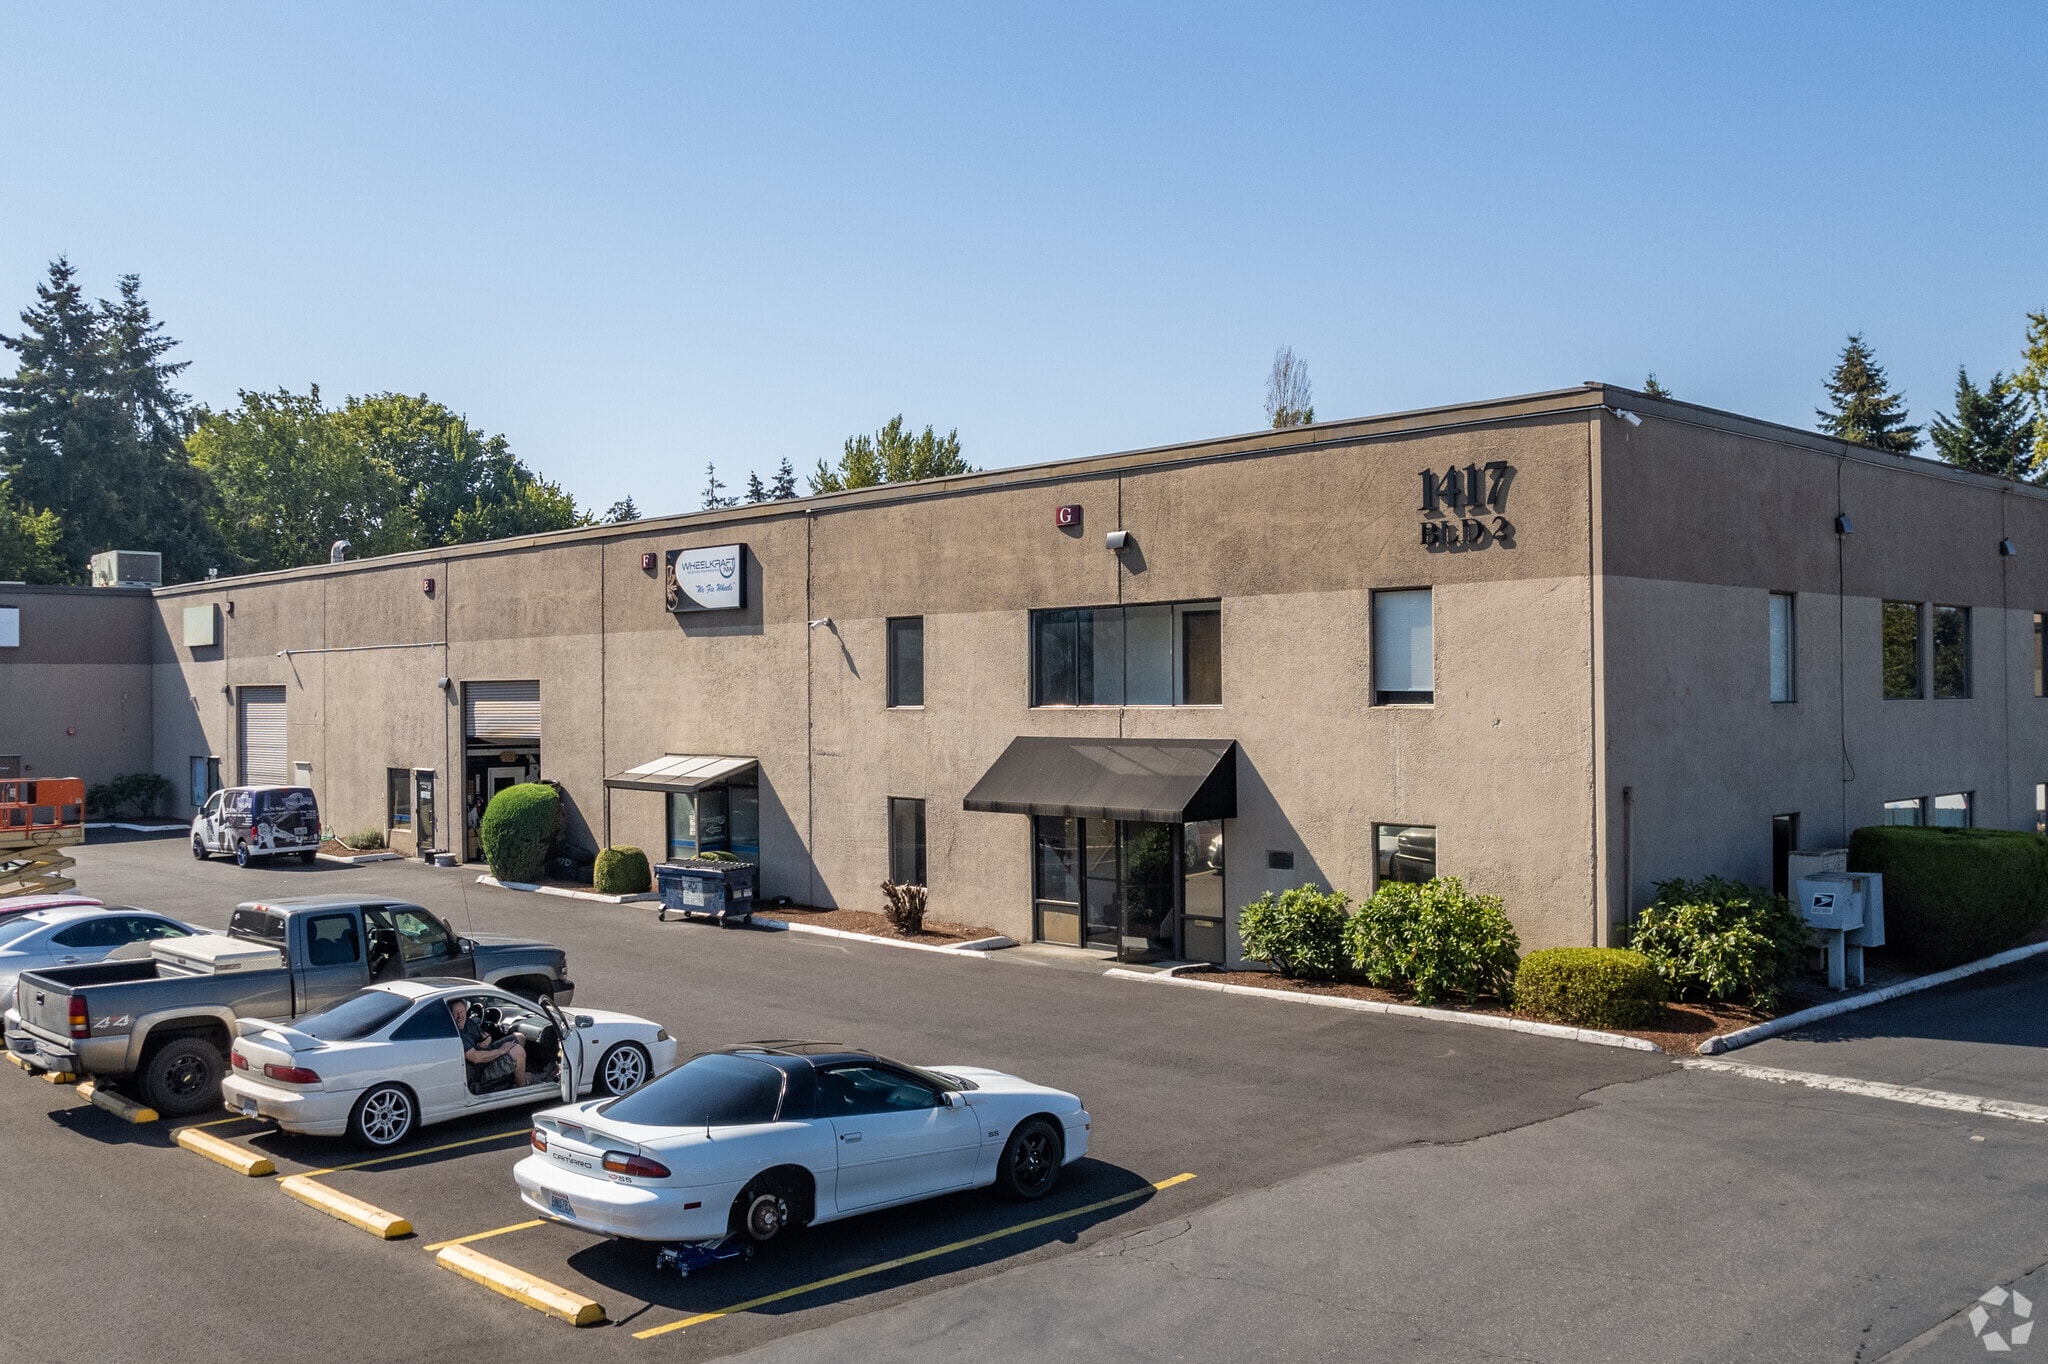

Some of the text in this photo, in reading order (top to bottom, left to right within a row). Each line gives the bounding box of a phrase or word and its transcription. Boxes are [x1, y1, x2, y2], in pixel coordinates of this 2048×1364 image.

[1417, 460, 1508, 511] 1417
[1059, 507, 1072, 523] G
[1420, 516, 1507, 545] BLD 2
[641, 554, 650, 567] F
[681, 557, 735, 571] WHEELKRAFT
[706, 583, 715, 594] Fix
[988, 1130, 999, 1138] SS
[552, 1152, 592, 1169] CAMARO
[618, 1176, 633, 1184] SS
